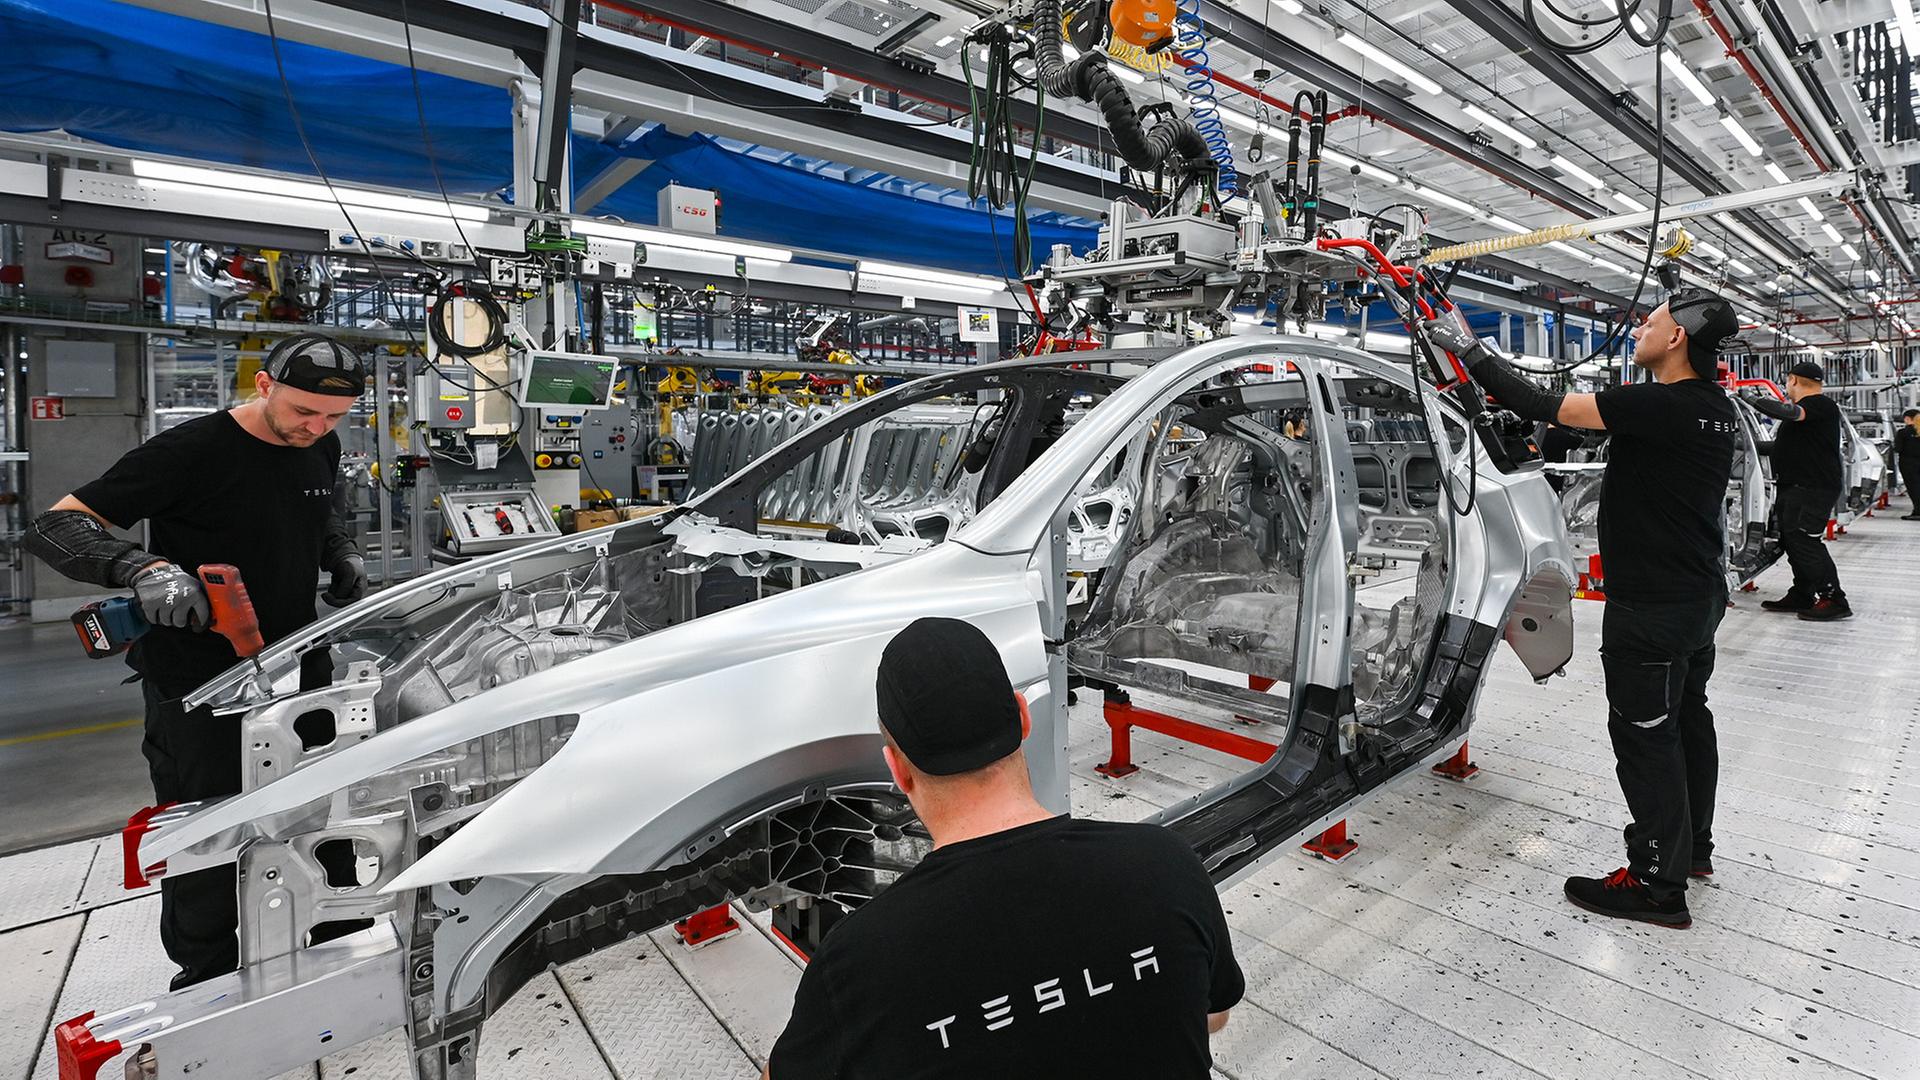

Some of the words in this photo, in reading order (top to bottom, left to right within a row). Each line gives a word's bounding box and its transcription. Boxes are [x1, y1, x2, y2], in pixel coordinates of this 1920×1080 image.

[683, 206, 707, 217] CSG
[1640, 839, 1660, 886] TSLA
[925, 945, 1160, 1049] TESLA
